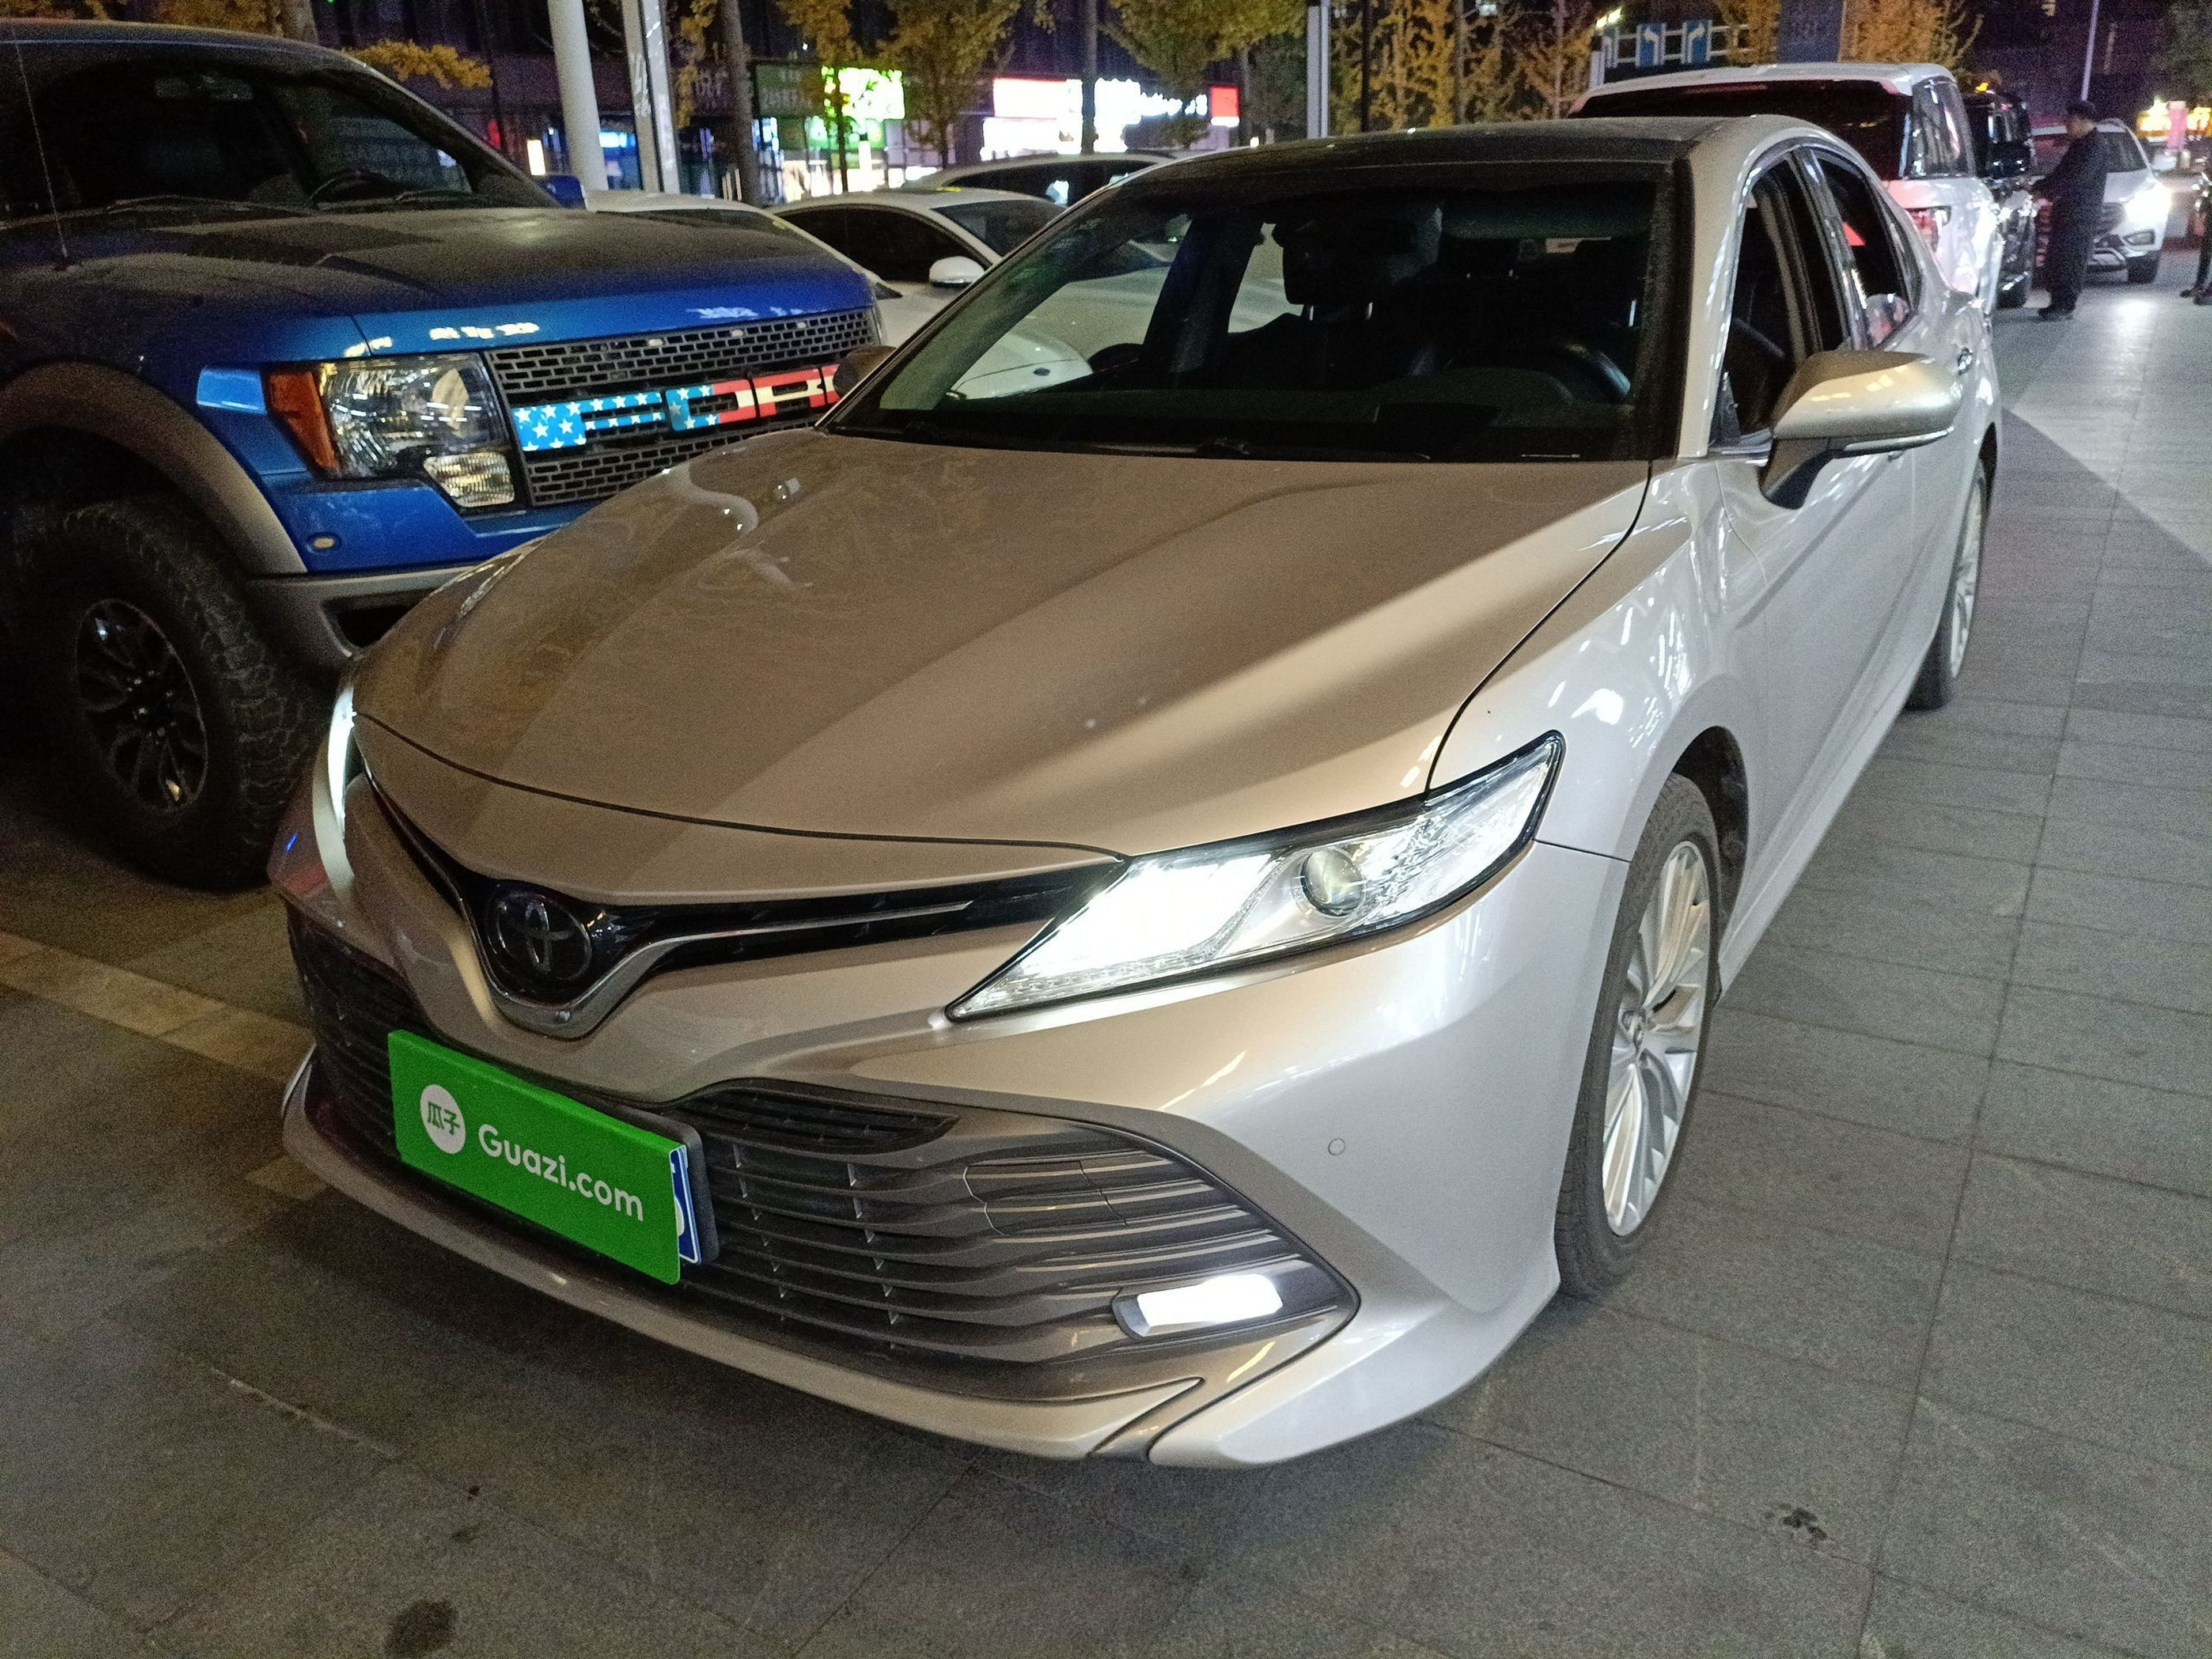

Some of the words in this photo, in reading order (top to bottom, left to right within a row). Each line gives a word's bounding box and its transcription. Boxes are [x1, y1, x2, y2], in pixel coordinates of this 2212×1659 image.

[511, 364, 840, 452] FOR
[427, 1101, 461, 1135] 瓜子
[478, 1124, 645, 1222] Guazi.com
